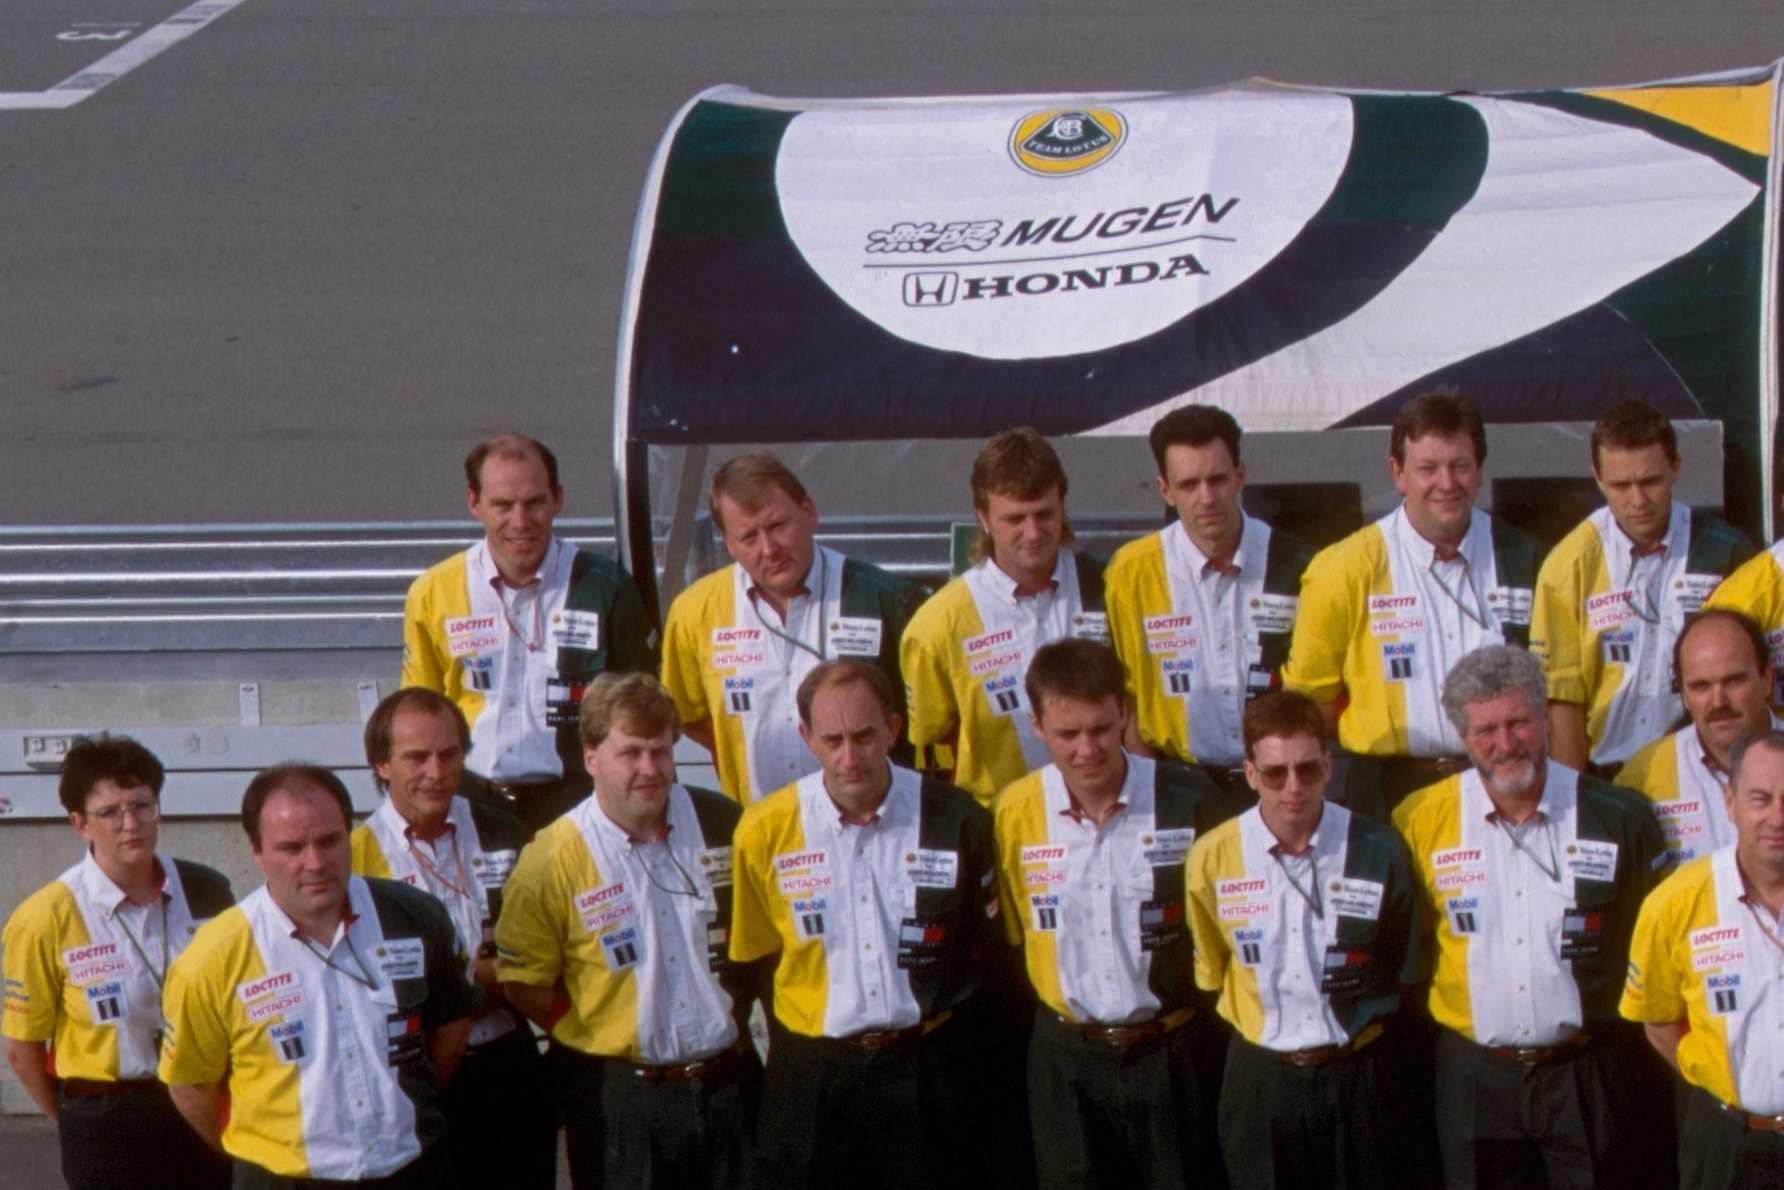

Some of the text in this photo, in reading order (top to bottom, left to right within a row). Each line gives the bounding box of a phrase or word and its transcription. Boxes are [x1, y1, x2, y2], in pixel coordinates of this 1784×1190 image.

[1028, 136, 1108, 154] TEAM LOTUS
[1000, 193, 1241, 247] MUGEN
[962, 254, 1210, 300] HONDA
[1371, 596, 1416, 609] LOCTITE
[449, 617, 496, 633] LOCTITE
[1146, 615, 1193, 630] LOCTITE
[1373, 618, 1423, 631] HITACHI
[717, 629, 761, 642] LOCTITE
[968, 629, 1013, 652] LOCTITE
[1603, 632, 1634, 643] Mobil
[452, 636, 498, 651] HITACHI
[1149, 637, 1196, 651] HITACHI
[1384, 643, 1414, 656] Mobil
[464, 657, 492, 670] Mobil
[716, 652, 764, 665] HITACHI
[973, 650, 1021, 671] HITACHI
[1163, 659, 1194, 672] Mobil
[725, 678, 753, 690] Mobil
[986, 675, 1017, 693] Mobil
[779, 852, 825, 868] LOCTITE
[1023, 847, 1064, 861] LOCTITE
[1437, 850, 1482, 865] LOCTITE
[784, 876, 831, 890] HITACHI
[1438, 873, 1484, 886] HITACHI
[1220, 880, 1265, 895] LOCTITE
[580, 883, 625, 908] LOCTITE
[1032, 895, 1059, 906] Mobil
[795, 899, 826, 912] Mobil
[1223, 902, 1269, 916] HITACHI
[1449, 899, 1478, 911] Mobil
[587, 906, 633, 929] HITACHI
[603, 928, 636, 947] Mobil
[1235, 930, 1263, 943] Mobil
[1694, 929, 1739, 946] LOCTITE
[69, 943, 117, 962] LOCTITE
[1697, 950, 1743, 966] HITACHI
[74, 962, 125, 980] HITACHI
[244, 973, 292, 998] LOCTITE
[1707, 974, 1740, 988] Mobil
[87, 983, 121, 1000] Mobil
[252, 995, 301, 1018] HITACHI
[271, 1022, 304, 1040] Mobil
